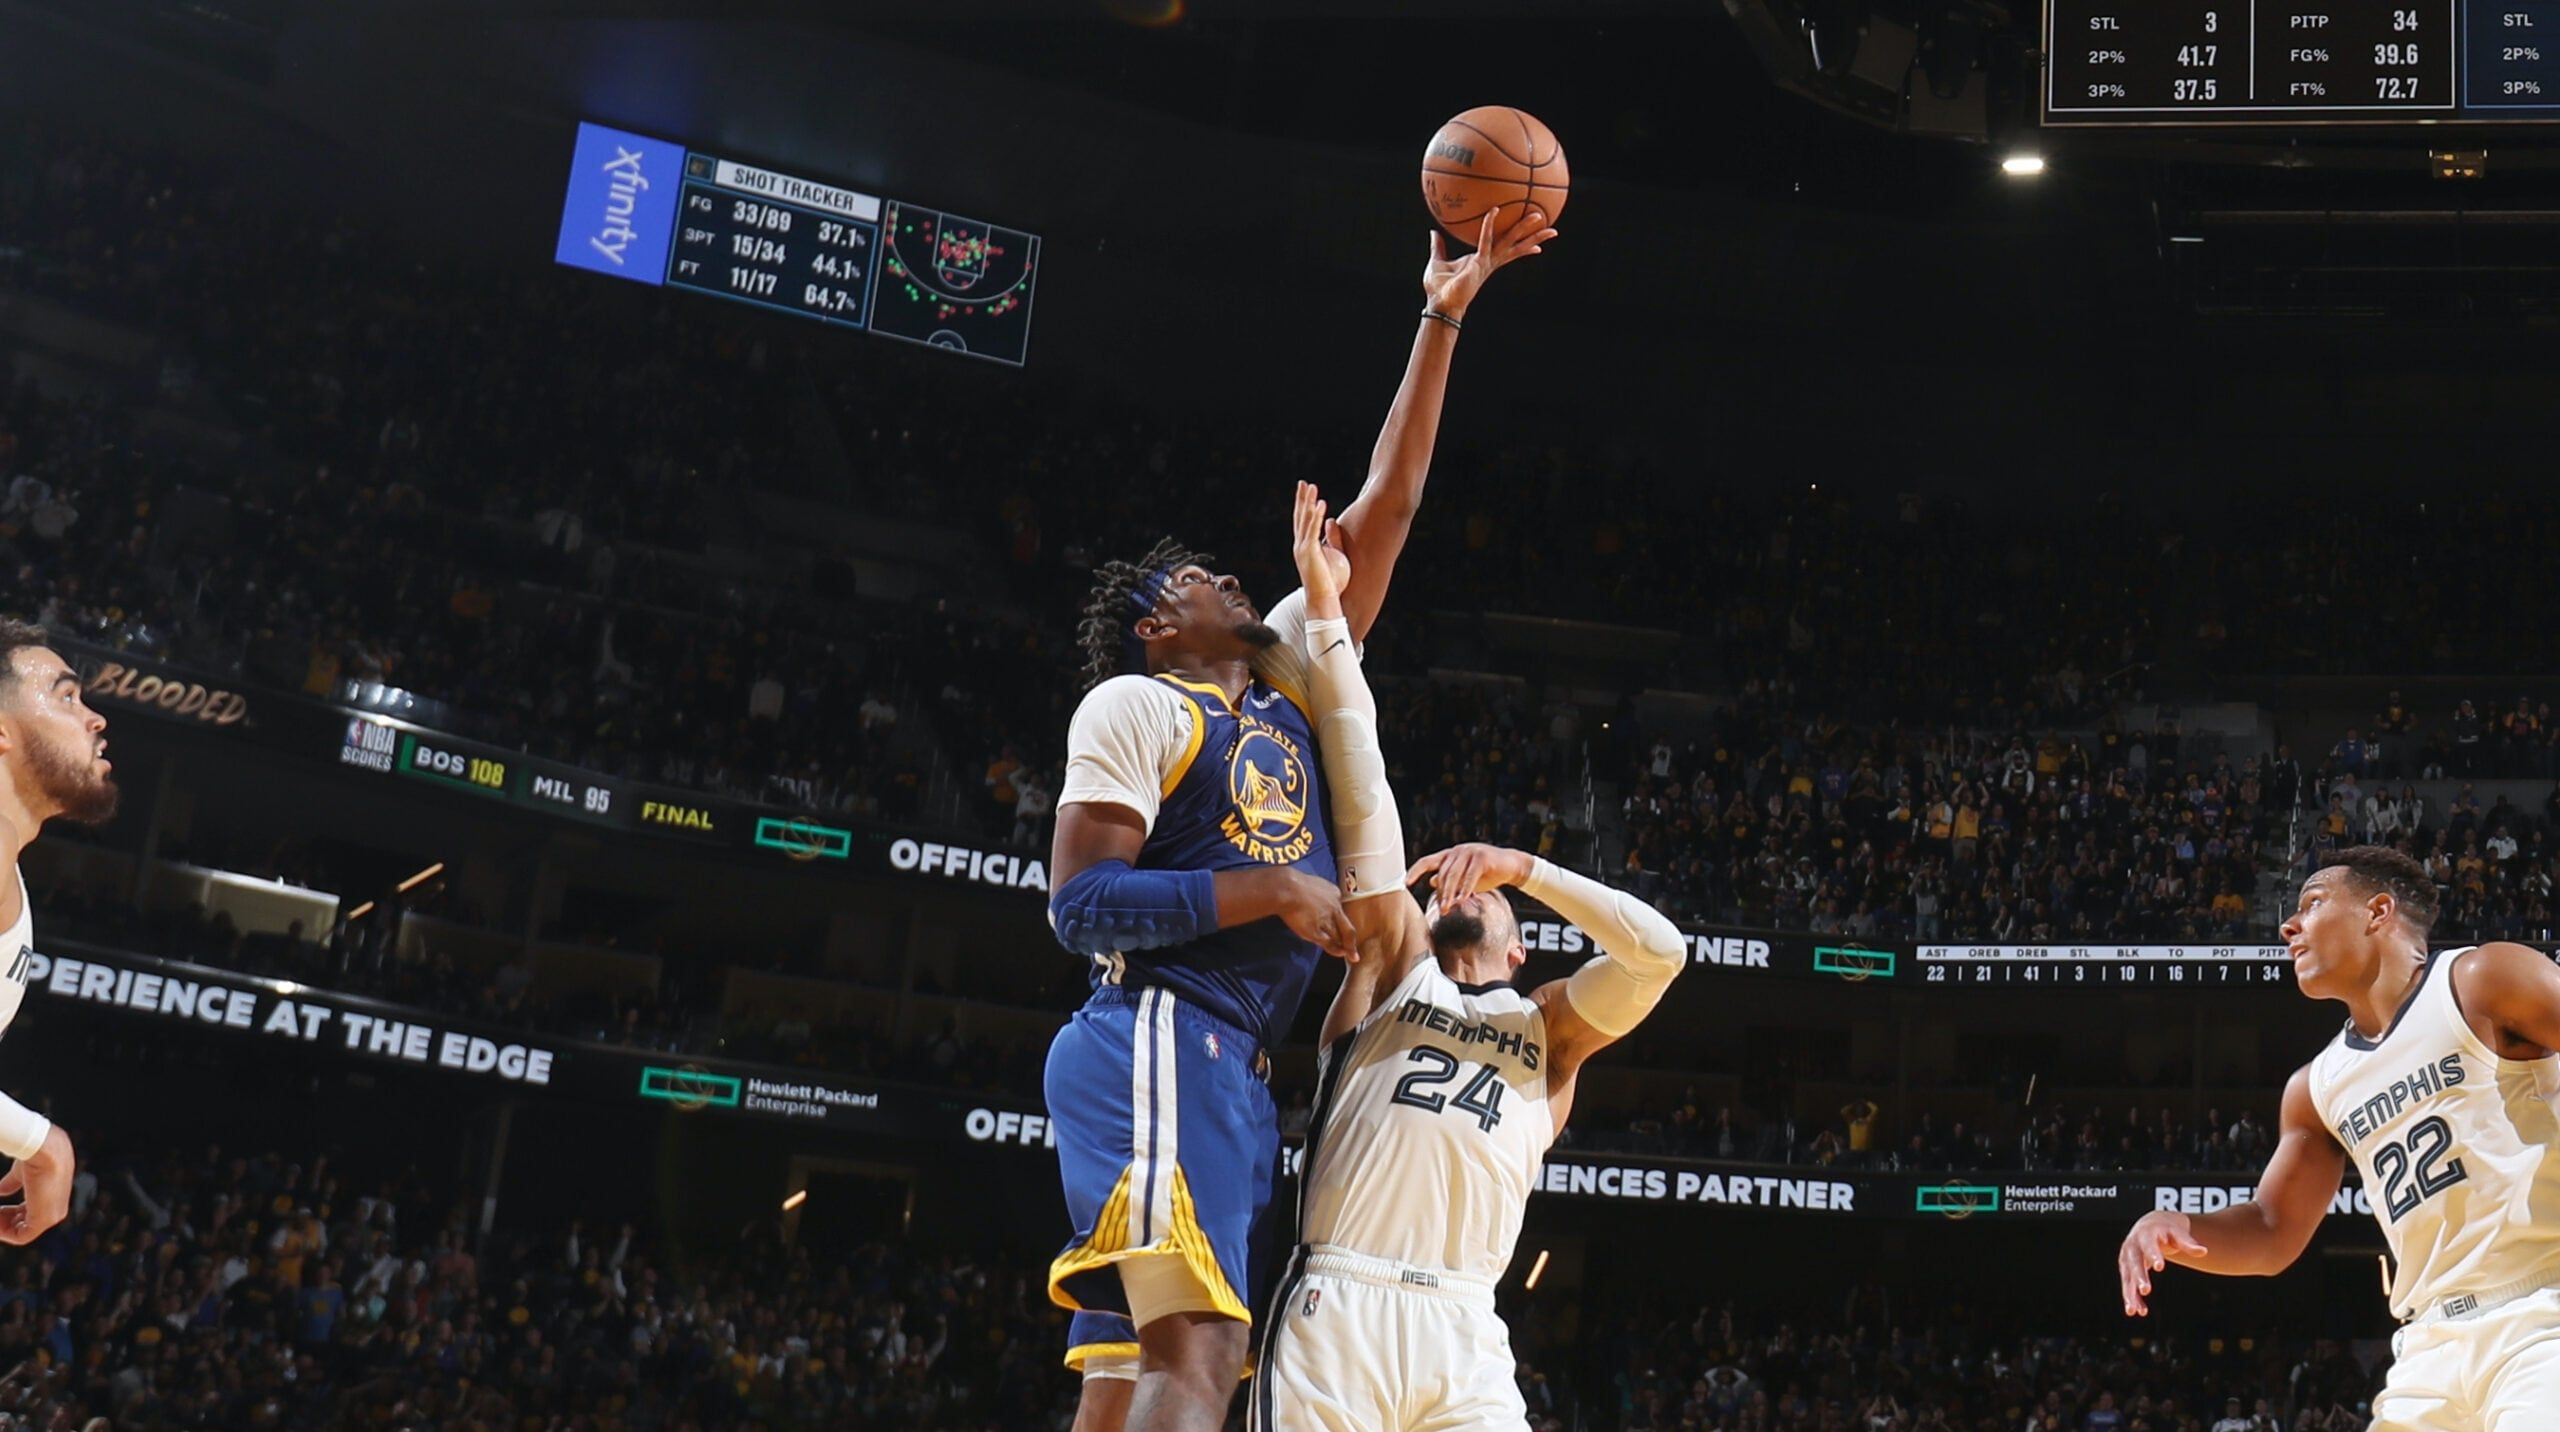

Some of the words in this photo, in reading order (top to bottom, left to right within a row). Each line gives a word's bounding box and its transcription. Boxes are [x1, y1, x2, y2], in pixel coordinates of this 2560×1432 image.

[2090, 17, 2120, 30] STL
[2205, 12, 2217, 33] 3
[2290, 15, 2329, 29] PITP
[2393, 10, 2418, 32] 34
[2503, 14, 2533, 27] STL
[2088, 50, 2125, 64] 2P%
[2177, 46, 2217, 67] 41.7
[2290, 48, 2329, 63] FG%
[2374, 44, 2418, 65] 39.6
[2503, 47, 2540, 62] 2P%
[2088, 84, 2125, 98] 3P%
[2174, 79, 2217, 101] 37.5
[2290, 82, 2325, 97] FT%
[2375, 78, 2418, 99] 72.7
[2503, 81, 2540, 95] 3P%
[734, 168, 778, 191] SHOT
[782, 178, 854, 211] TRACKER
[689, 195, 712, 211] FG
[733, 200, 792, 232] 33/89
[685, 227, 715, 246] 3PT
[732, 234, 786, 264] 15/34
[679, 259, 700, 275] FT
[730, 266, 777, 295] 11/17
[362, 722, 396, 755] NBA
[341, 745, 393, 773] SCORES
[415, 746, 465, 774] BOS
[469, 758, 505, 787] 108
[533, 775, 574, 802] MIL
[584, 786, 611, 813] 95
[642, 801, 714, 830] FINAL
[1283, 758, 1298, 792] 5
[1220, 812, 1314, 865] WARRIORS
[889, 838, 1049, 892] OFFICIA
[1926, 949, 1948, 958] AST
[1968, 949, 2000, 958] OREB
[2016, 949, 2048, 958] DREB
[2070, 949, 2091, 958] STL
[2117, 949, 2139, 958] BLK
[2168, 949, 2184, 958] TO
[2212, 949, 2236, 958] POT
[2258, 949, 2286, 958] PITP
[1927, 965, 1945, 981] 22
[1976, 965, 1991, 981] 21
[2023, 965, 2039, 981] 41
[2074, 965, 2084, 981] 3
[2119, 965, 2135, 981] 10
[2168, 965, 2183, 981] 16
[2219, 965, 2228, 981] 7
[2262, 965, 2280, 981] 34
[27, 951, 256, 1028] PERIENCE
[263, 1000, 332, 1041] AT
[342, 1011, 433, 1062] THE
[438, 1031, 553, 1085] EDGE
[1397, 998, 1540, 1071] MEMPHS
[748, 1078, 811, 1099] Hewlett
[813, 1086, 879, 1108] Packard
[1390, 1044, 1505, 1134] 24
[2338, 1053, 2466, 1151] MEMPHIS
[745, 1094, 827, 1117] Enterprise
[965, 1108, 1056, 1149] OFFI
[2373, 1115, 2468, 1225] 22
[1534, 1163, 1667, 1199] IENCES
[1676, 1171, 1855, 1211] PARTNER
[2005, 1185, 2059, 1198] Hewlett
[2062, 1186, 2117, 1198] Packard
[2004, 1199, 2074, 1213] Enterprise
